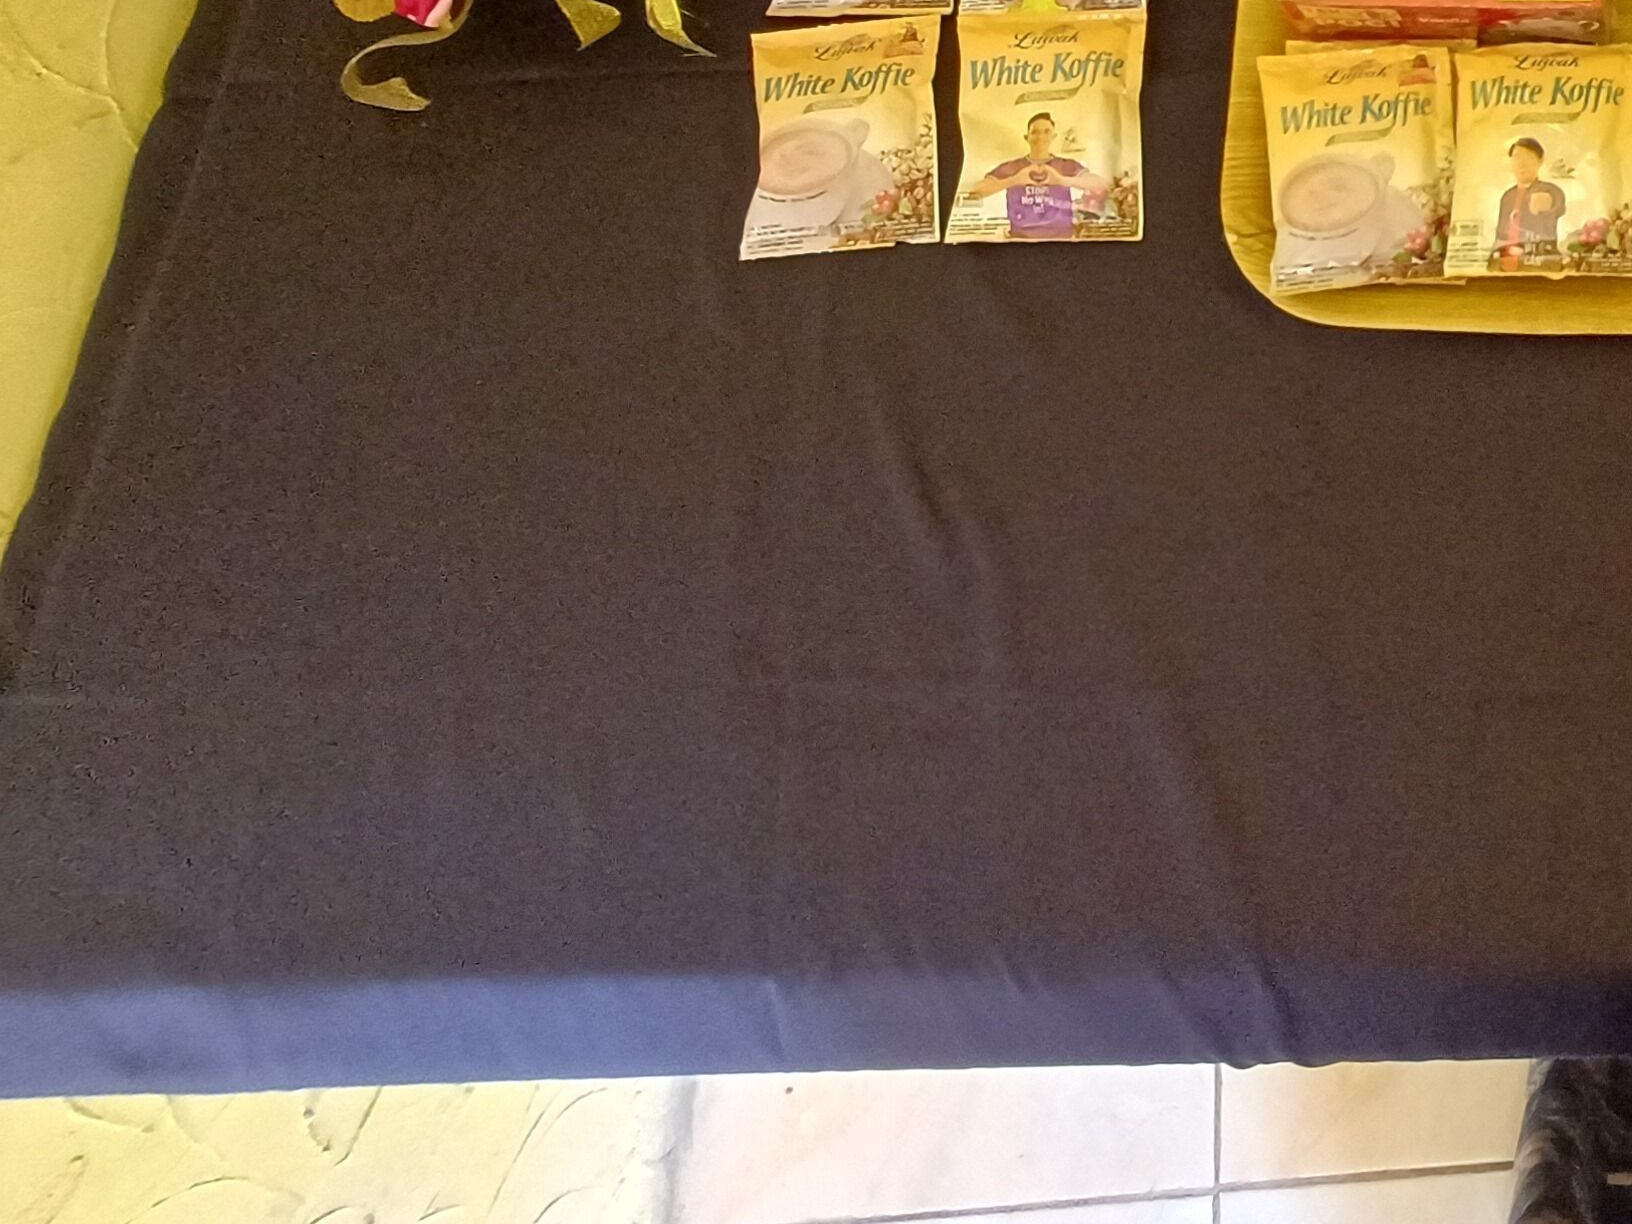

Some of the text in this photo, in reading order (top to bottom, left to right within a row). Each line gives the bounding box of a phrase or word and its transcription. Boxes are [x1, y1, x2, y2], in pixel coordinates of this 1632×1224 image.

[764, 62, 915, 103] White Koffie
[970, 51, 1125, 90] White Koffie
[1281, 92, 1431, 135] White Koffie
[1470, 76, 1624, 113] White Koffie
